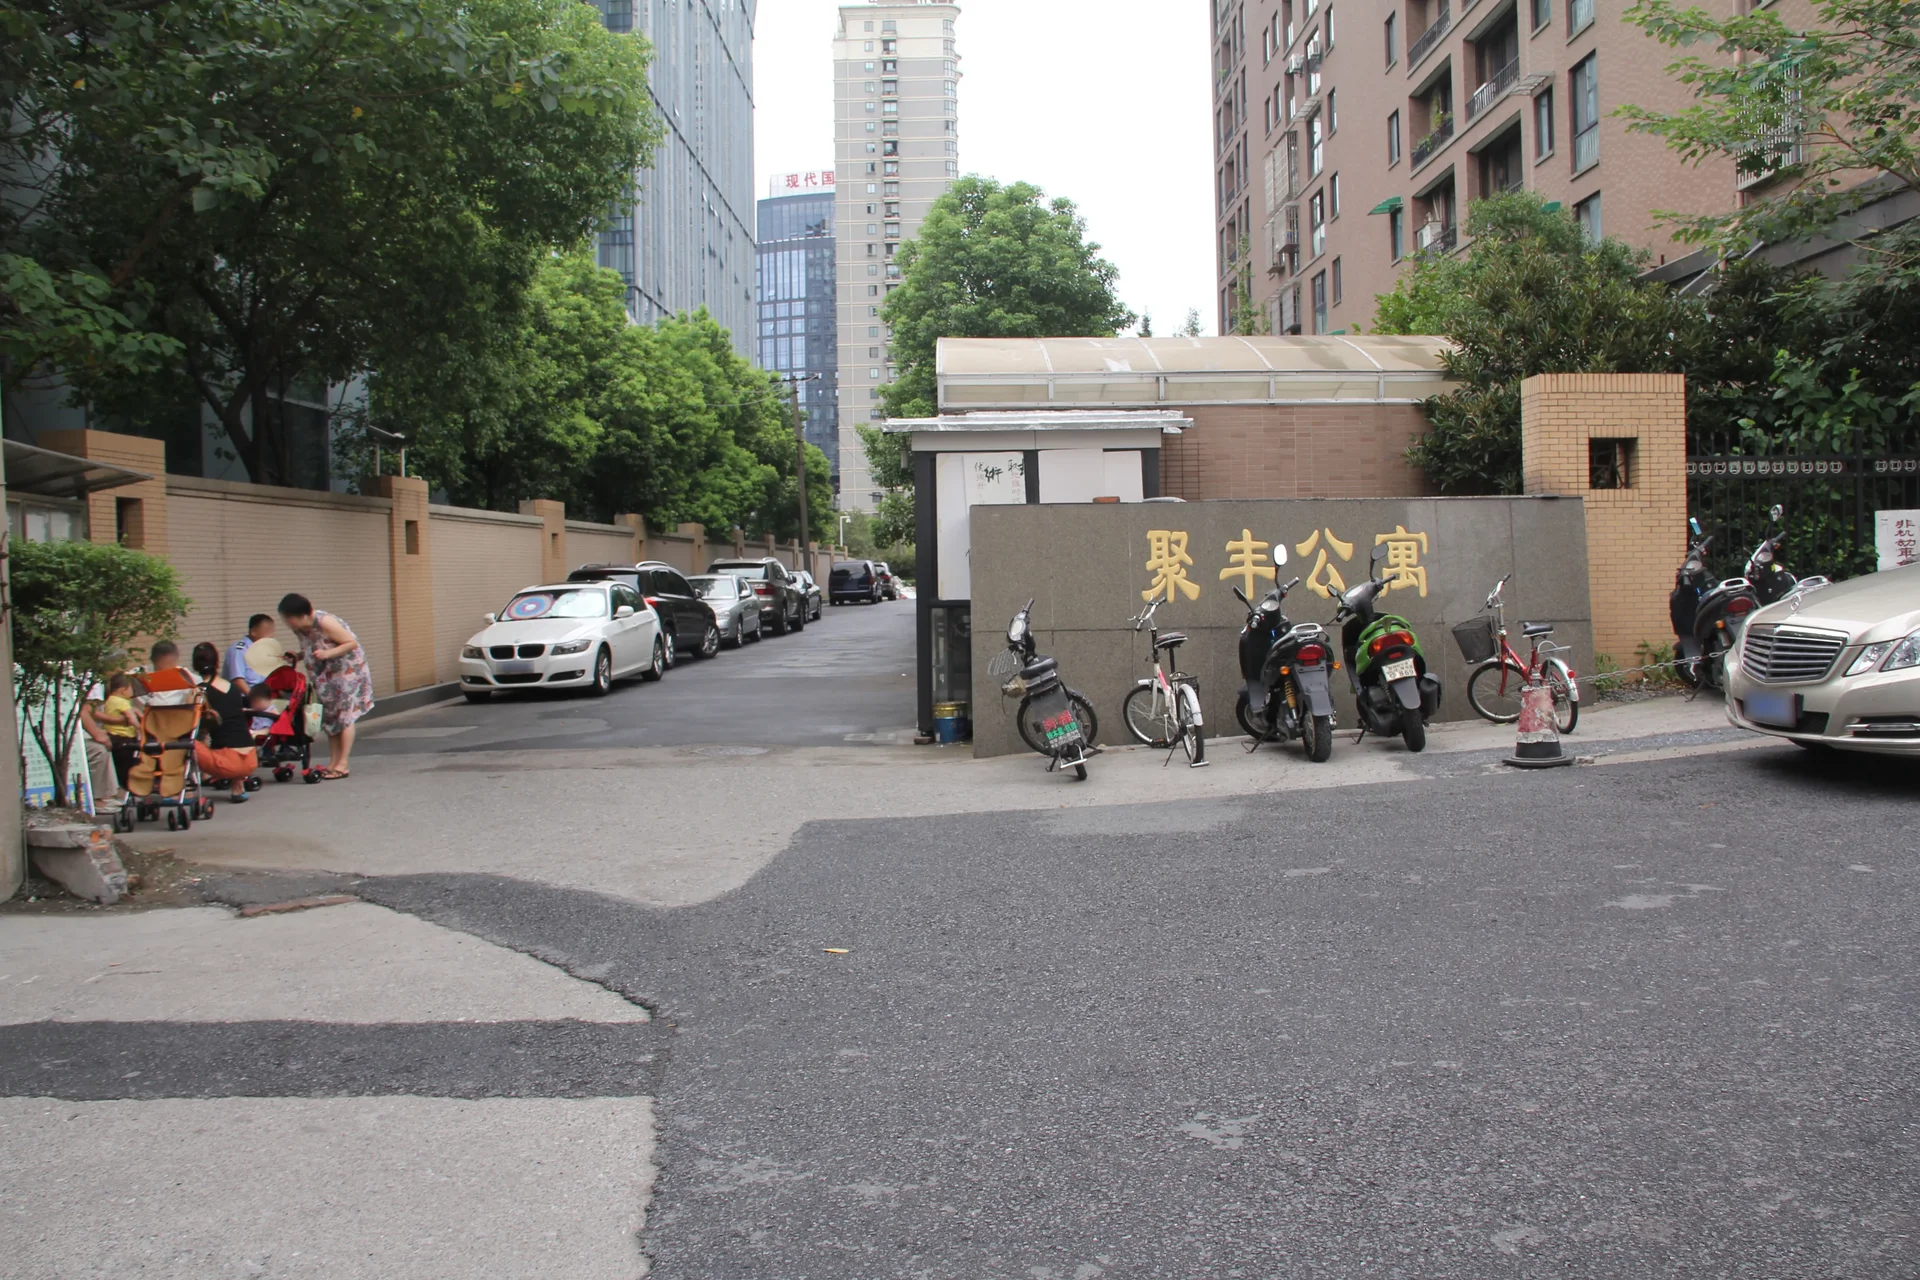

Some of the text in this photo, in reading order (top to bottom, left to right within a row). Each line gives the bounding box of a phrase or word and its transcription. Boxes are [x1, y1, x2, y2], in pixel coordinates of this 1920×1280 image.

[786, 171, 834, 188] 现代国
[1142, 525, 1428, 603] 聚丰公寓
